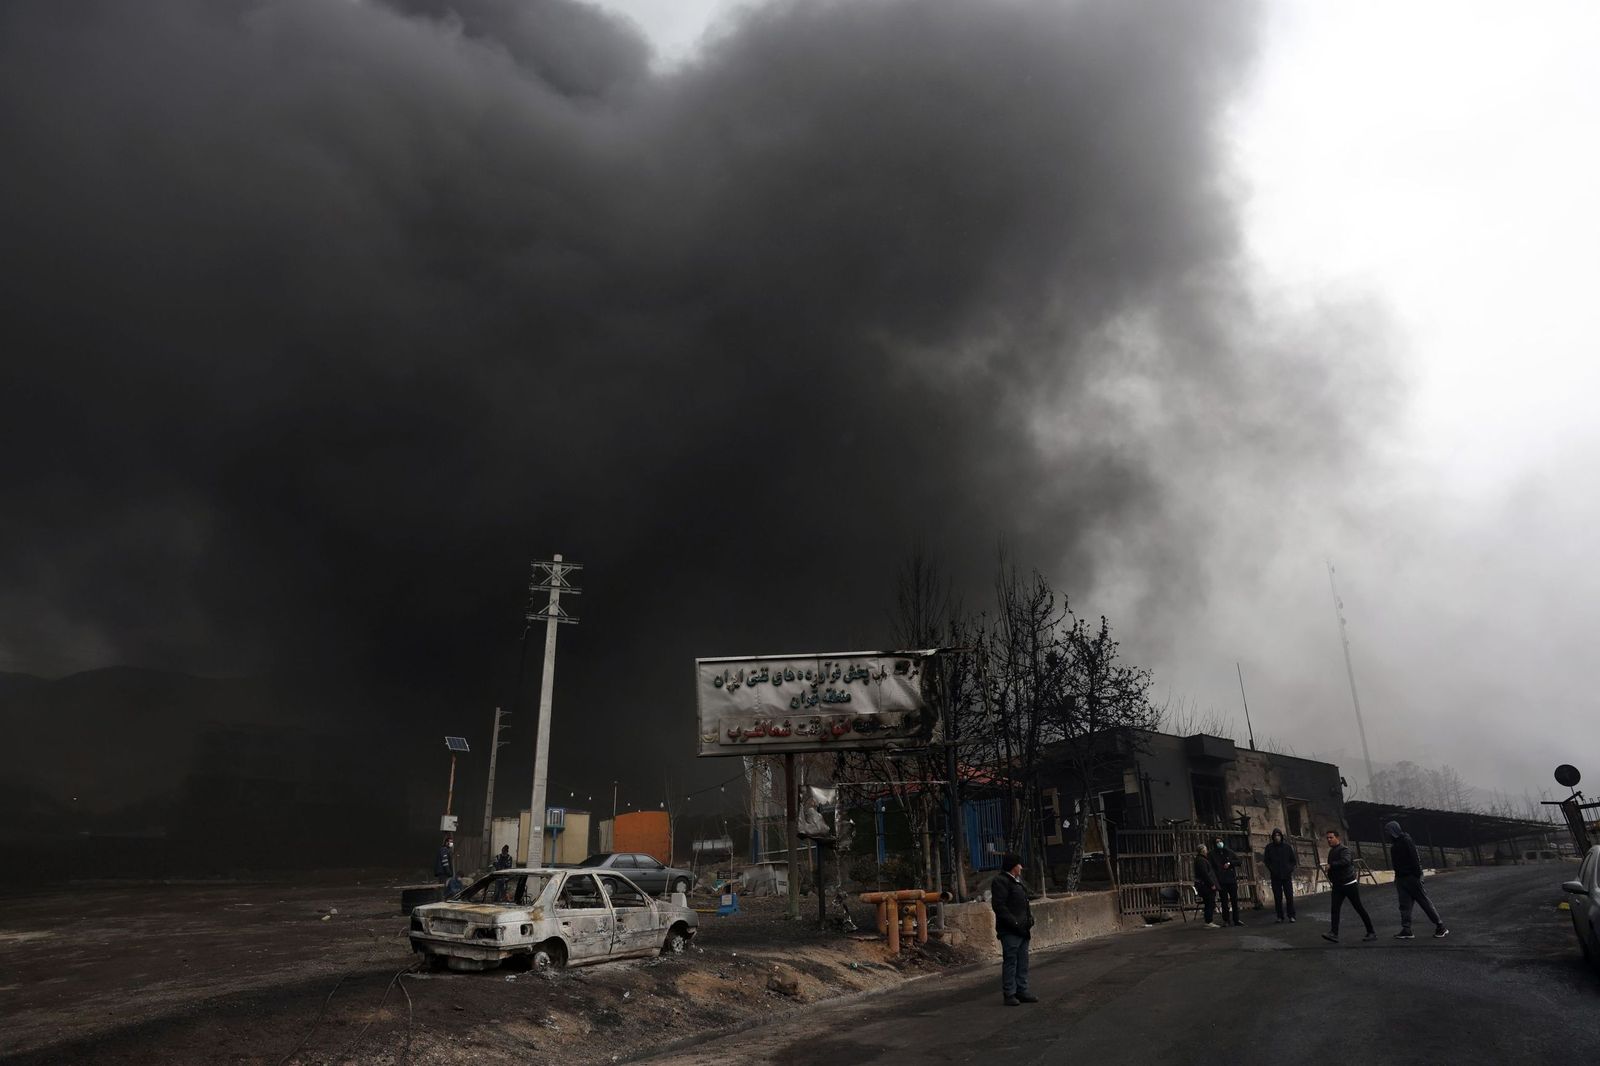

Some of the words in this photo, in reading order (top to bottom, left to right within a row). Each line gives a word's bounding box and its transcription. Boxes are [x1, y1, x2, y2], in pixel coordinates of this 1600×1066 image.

[747, 667, 769, 687] نفتی
[843, 664, 869, 686] پخش
[823, 688, 851, 703] منطقه
